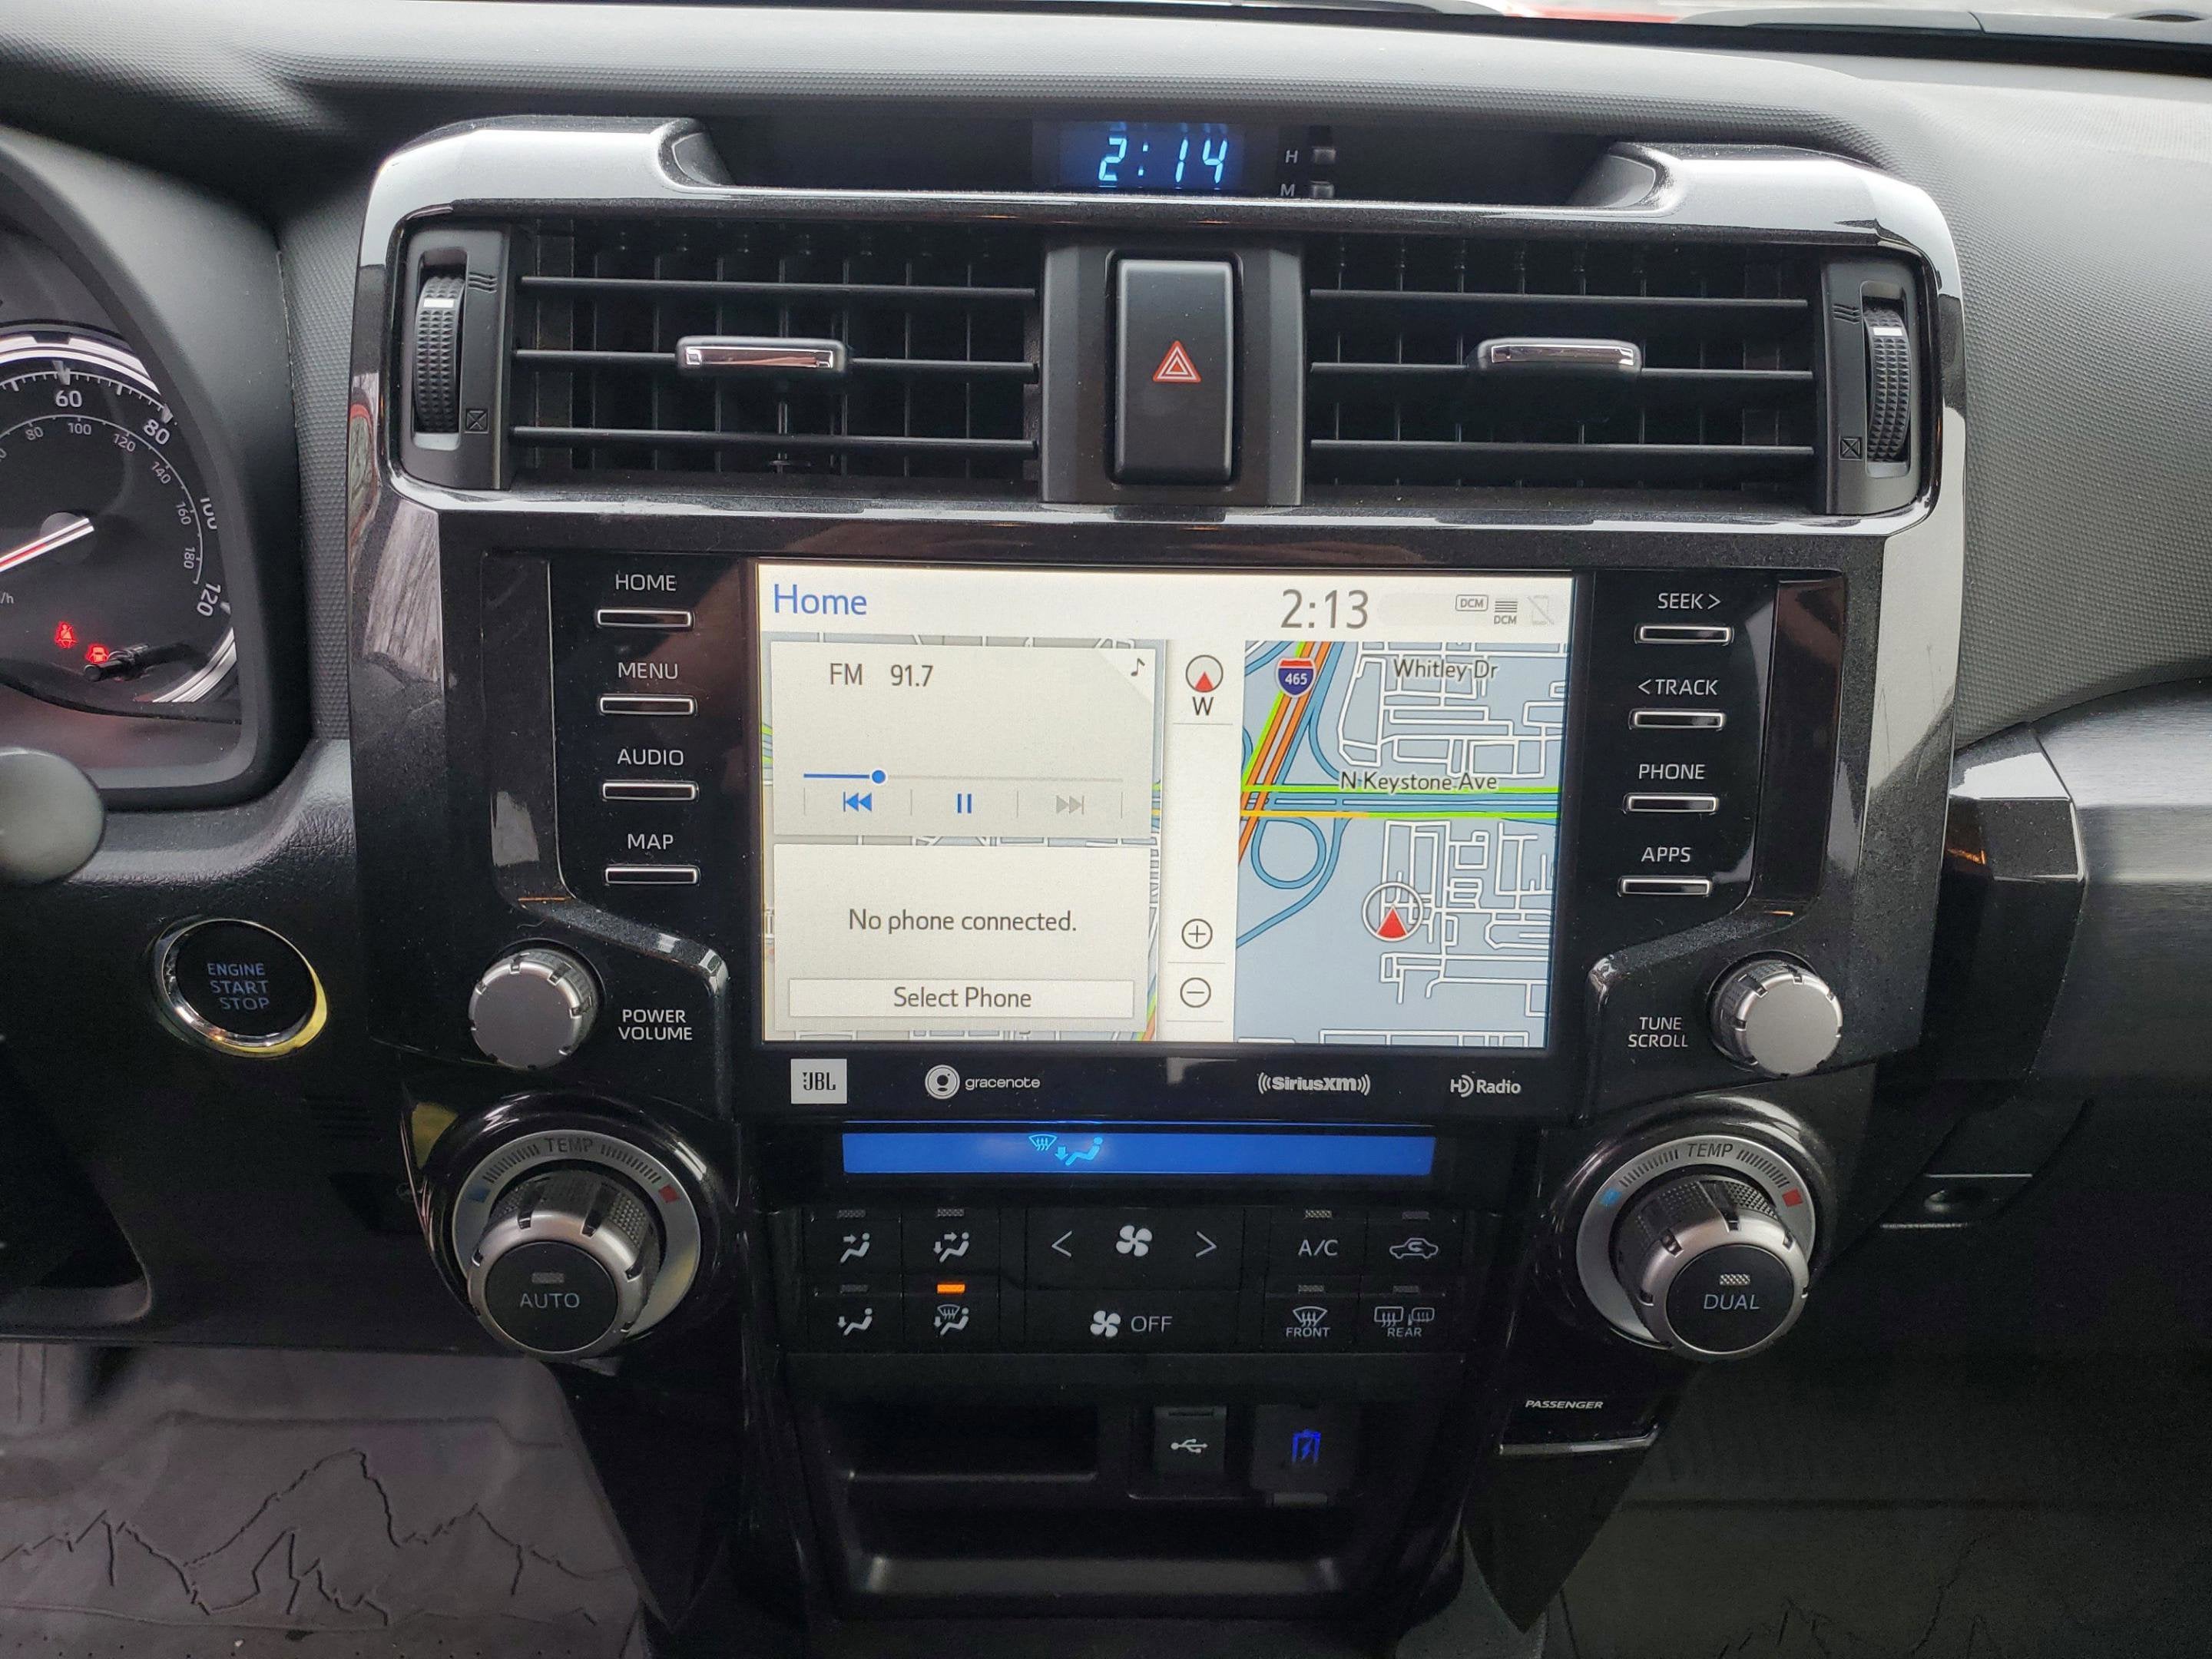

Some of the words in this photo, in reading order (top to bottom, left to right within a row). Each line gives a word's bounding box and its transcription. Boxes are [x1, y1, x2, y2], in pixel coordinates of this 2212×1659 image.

[1285, 151, 1298, 164] H
[1280, 184, 1295, 197] M
[55, 390, 82, 408] 60
[25, 426, 44, 440] 80
[68, 422, 91, 435] 100
[144, 419, 170, 445] 80
[113, 432, 136, 452] 120
[151, 461, 171, 485] 140
[175, 501, 192, 525] 160
[183, 546, 196, 570] 180
[615, 574, 677, 591] HOME
[196, 583, 221, 617] 120
[773, 584, 868, 615] Home
[1460, 599, 1484, 608] DCM
[1280, 589, 1369, 629] 2:13
[1493, 615, 1517, 625] DCM
[618, 662, 679, 680] MENU
[829, 664, 863, 686] FM
[890, 665, 934, 687] 91.7
[1394, 658, 1465, 680] Whitley
[1474, 660, 1498, 678] Dr
[1284, 674, 1308, 686] 465
[1192, 696, 1214, 716] W
[617, 749, 684, 766] AUDIO
[1639, 763, 1706, 780] PHONE
[1341, 772, 1356, 789] N
[1362, 772, 1452, 793] Keystone
[1459, 772, 1498, 790] Ave
[628, 834, 674, 849] MAP
[1641, 846, 1691, 863] APPS
[849, 909, 882, 930] No
[888, 909, 955, 934] phone
[961, 911, 1077, 932] connected.
[207, 963, 266, 976] ENGINE
[210, 980, 269, 994] START
[220, 998, 270, 1010] STOP
[894, 987, 959, 1008] Select
[965, 987, 1031, 1008] Phone
[622, 1009, 686, 1023] POWER
[1639, 1017, 1682, 1031] TUNE
[618, 1027, 693, 1041] VOLUME
[1628, 1034, 1688, 1048] SCROLL
[803, 1071, 836, 1091] JBL
[965, 1077, 1041, 1091] gracenote
[1476, 1079, 1522, 1094] Radio
[544, 1137, 593, 1152] TEMP
[1687, 1144, 1734, 1157] TEMP
[1298, 1239, 1339, 1257] A/C
[519, 1293, 580, 1308] AUTO
[1703, 1293, 1760, 1310] DUAL
[1131, 1316, 1173, 1333] OFF
[1285, 1327, 1331, 1338] FRONT
[1387, 1328, 1422, 1337] REAR
[1525, 1400, 1604, 1409] PASSENGER
